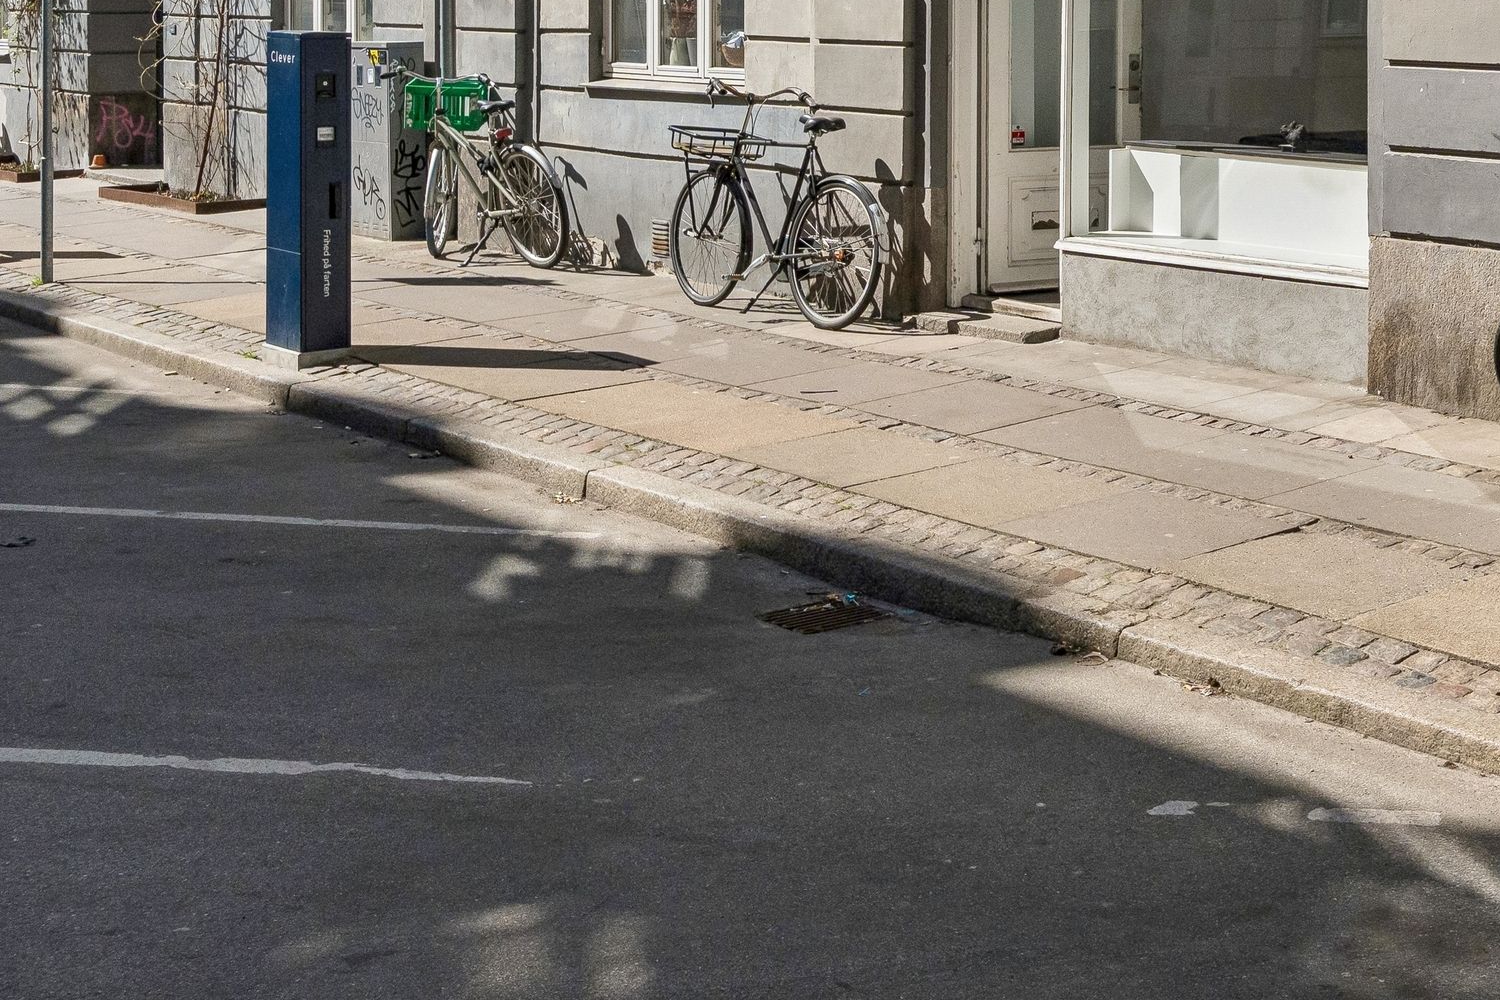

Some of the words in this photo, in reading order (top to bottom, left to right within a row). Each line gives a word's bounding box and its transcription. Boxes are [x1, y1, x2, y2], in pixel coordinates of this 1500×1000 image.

[270, 50, 296, 64] Clever
[323, 229, 332, 257] Frihed
[322, 258, 332, 269] på
[323, 271, 332, 298] farten
